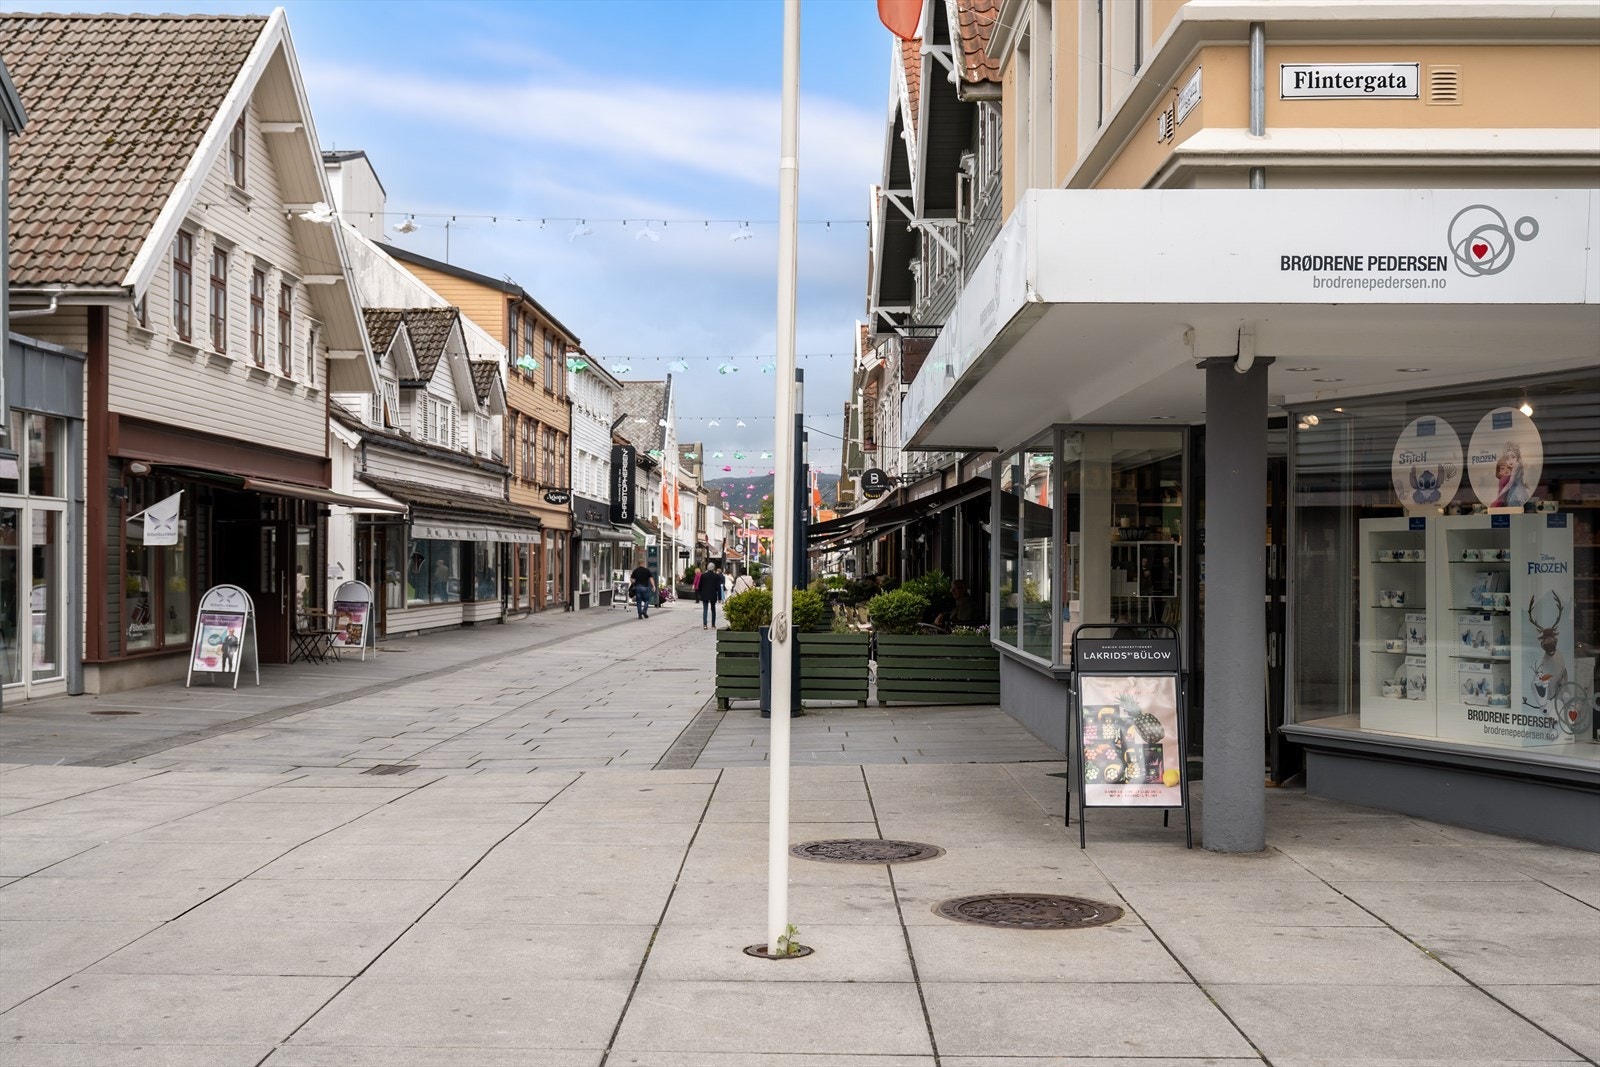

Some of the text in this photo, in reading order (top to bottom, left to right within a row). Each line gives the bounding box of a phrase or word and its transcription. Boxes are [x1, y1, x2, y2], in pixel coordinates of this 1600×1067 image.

[1293, 70, 1407, 93] Flintergata
[1280, 254, 1448, 272] BRØDRENE PEDERSEN
[1312, 275, 1447, 292] brodrenepedersen.no
[1471, 453, 1497, 465] FROZEN
[870, 472, 880, 485] B
[1527, 561, 1568, 575] FROZEN
[1083, 652, 1127, 660] LAKRIDS
[1133, 650, 1171, 660] BÜLOW
[1467, 709, 1556, 730] BRØDRENE PEDERSEN
[1483, 725, 1556, 741] brodrenepedersen.no
